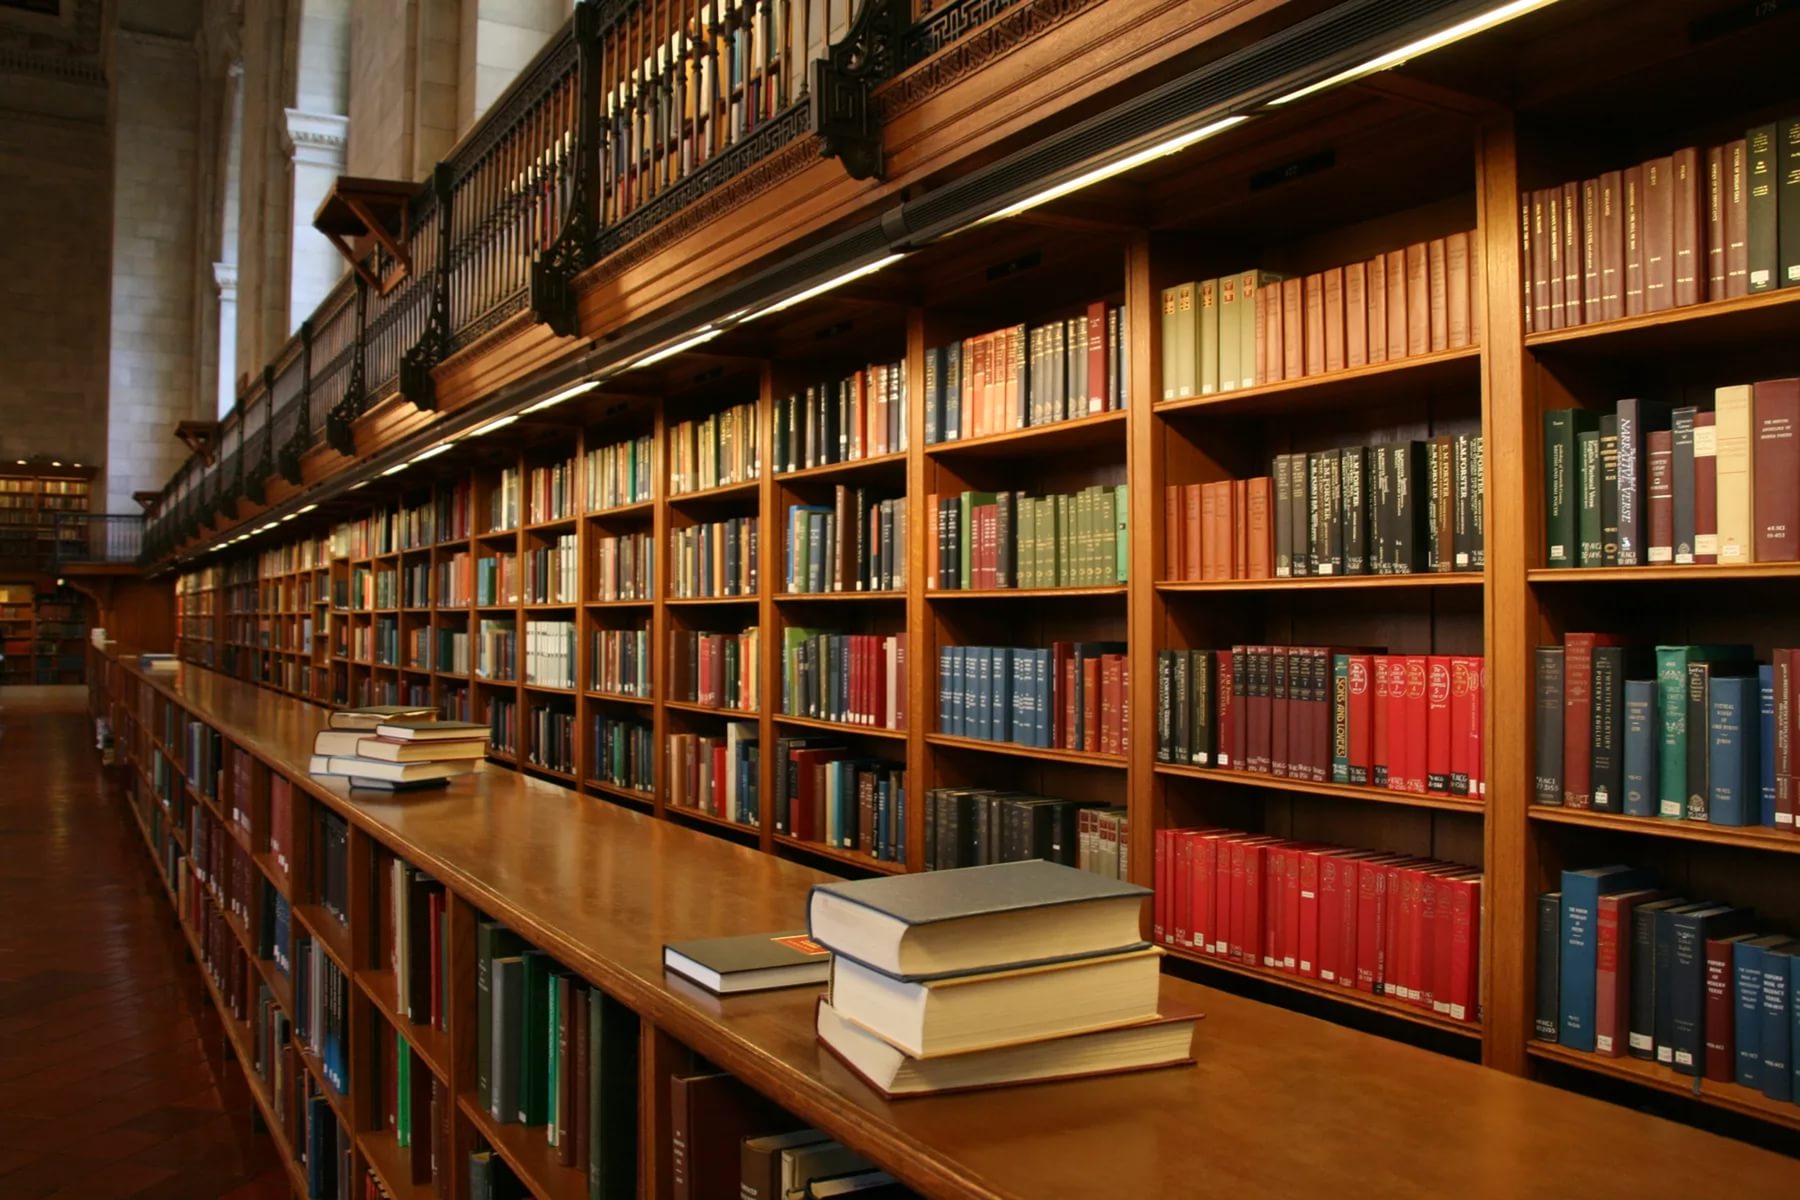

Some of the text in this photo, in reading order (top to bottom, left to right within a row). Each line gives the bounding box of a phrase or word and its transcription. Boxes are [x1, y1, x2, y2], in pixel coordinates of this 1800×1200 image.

[1621, 418, 1631, 523] NARRATIVE VERSE
[1336, 679, 1345, 756] SONS AND LOVERS
